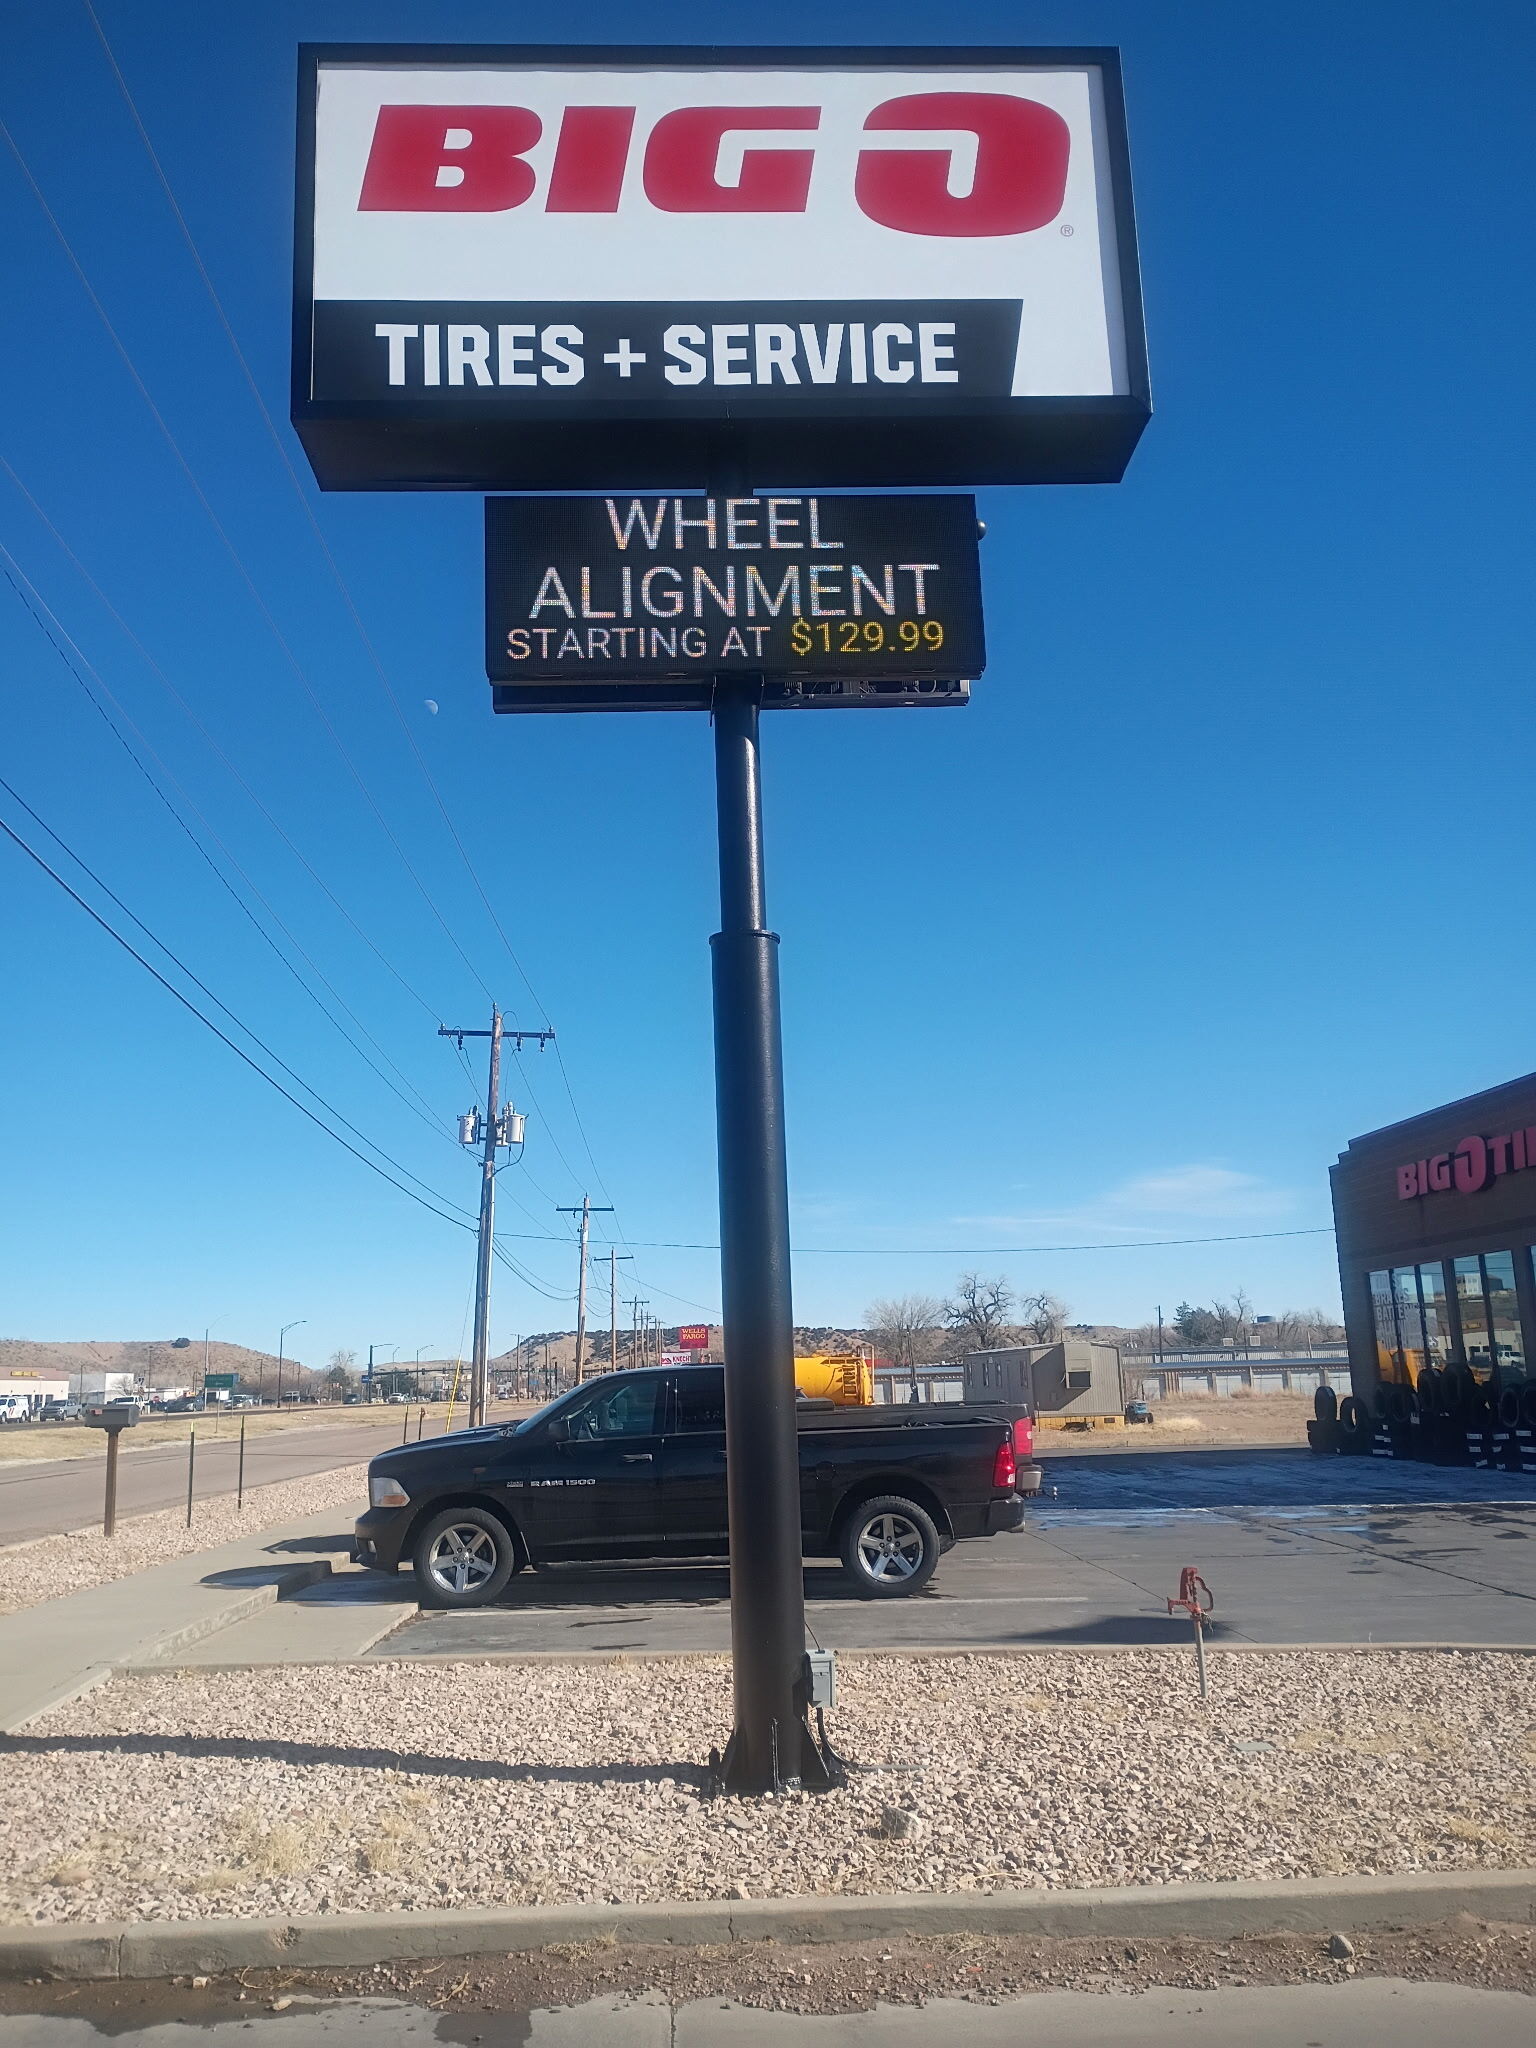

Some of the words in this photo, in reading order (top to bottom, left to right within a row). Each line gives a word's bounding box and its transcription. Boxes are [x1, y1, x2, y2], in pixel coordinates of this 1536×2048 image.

[358, 105, 821, 213] BIG
[855, 92, 1071, 237] O
[375, 323, 585, 386] TIRES
[603, 338, 647, 377] +
[663, 322, 959, 386] SERVICE
[605, 498, 844, 550] WHEEL
[528, 563, 940, 618] ALIGNMENT
[506, 627, 707, 660] STARTING
[720, 626, 771, 657] AT
[791, 619, 944, 656] $129.99
[1396, 1152, 1451, 1201] BIG
[1454, 1135, 1487, 1194] O
[565, 1478, 596, 1486] 1500
